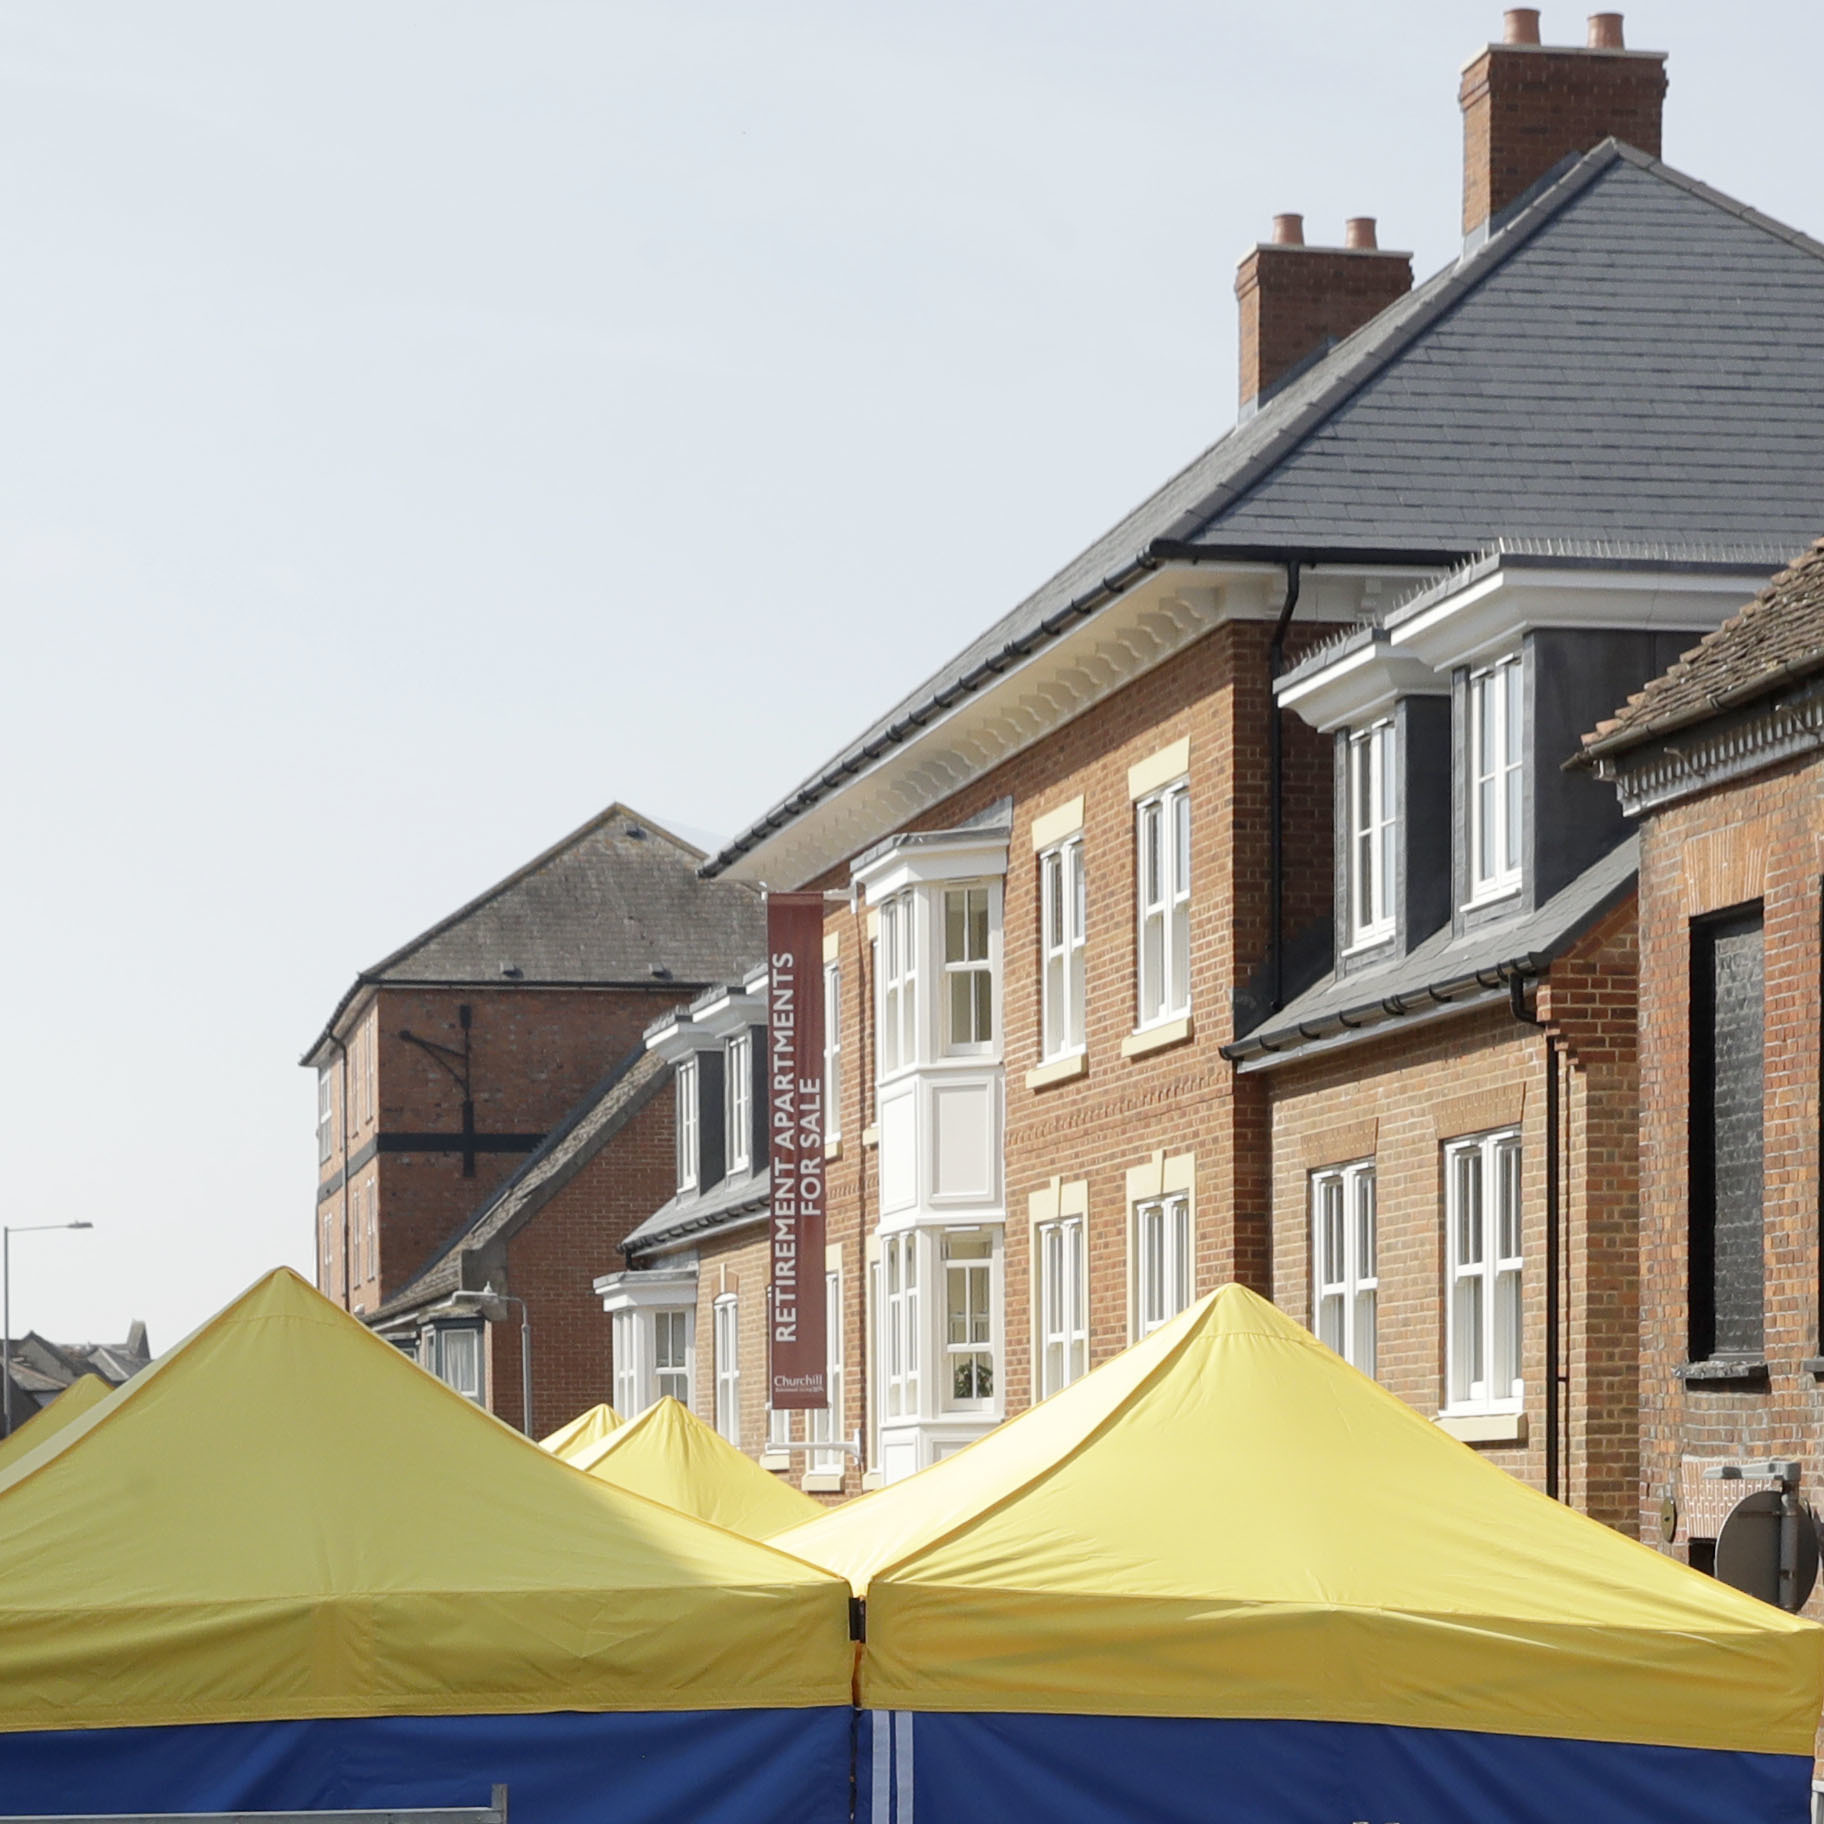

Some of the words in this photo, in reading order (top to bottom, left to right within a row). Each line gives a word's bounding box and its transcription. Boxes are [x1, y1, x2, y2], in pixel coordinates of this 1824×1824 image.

[772, 952, 795, 1151] APARTMENTS
[799, 1077, 821, 1148] SALE
[799, 1157, 822, 1216] FOR
[774, 1157, 796, 1343] RETIREMENT
[774, 1373, 823, 1387] Churchill
